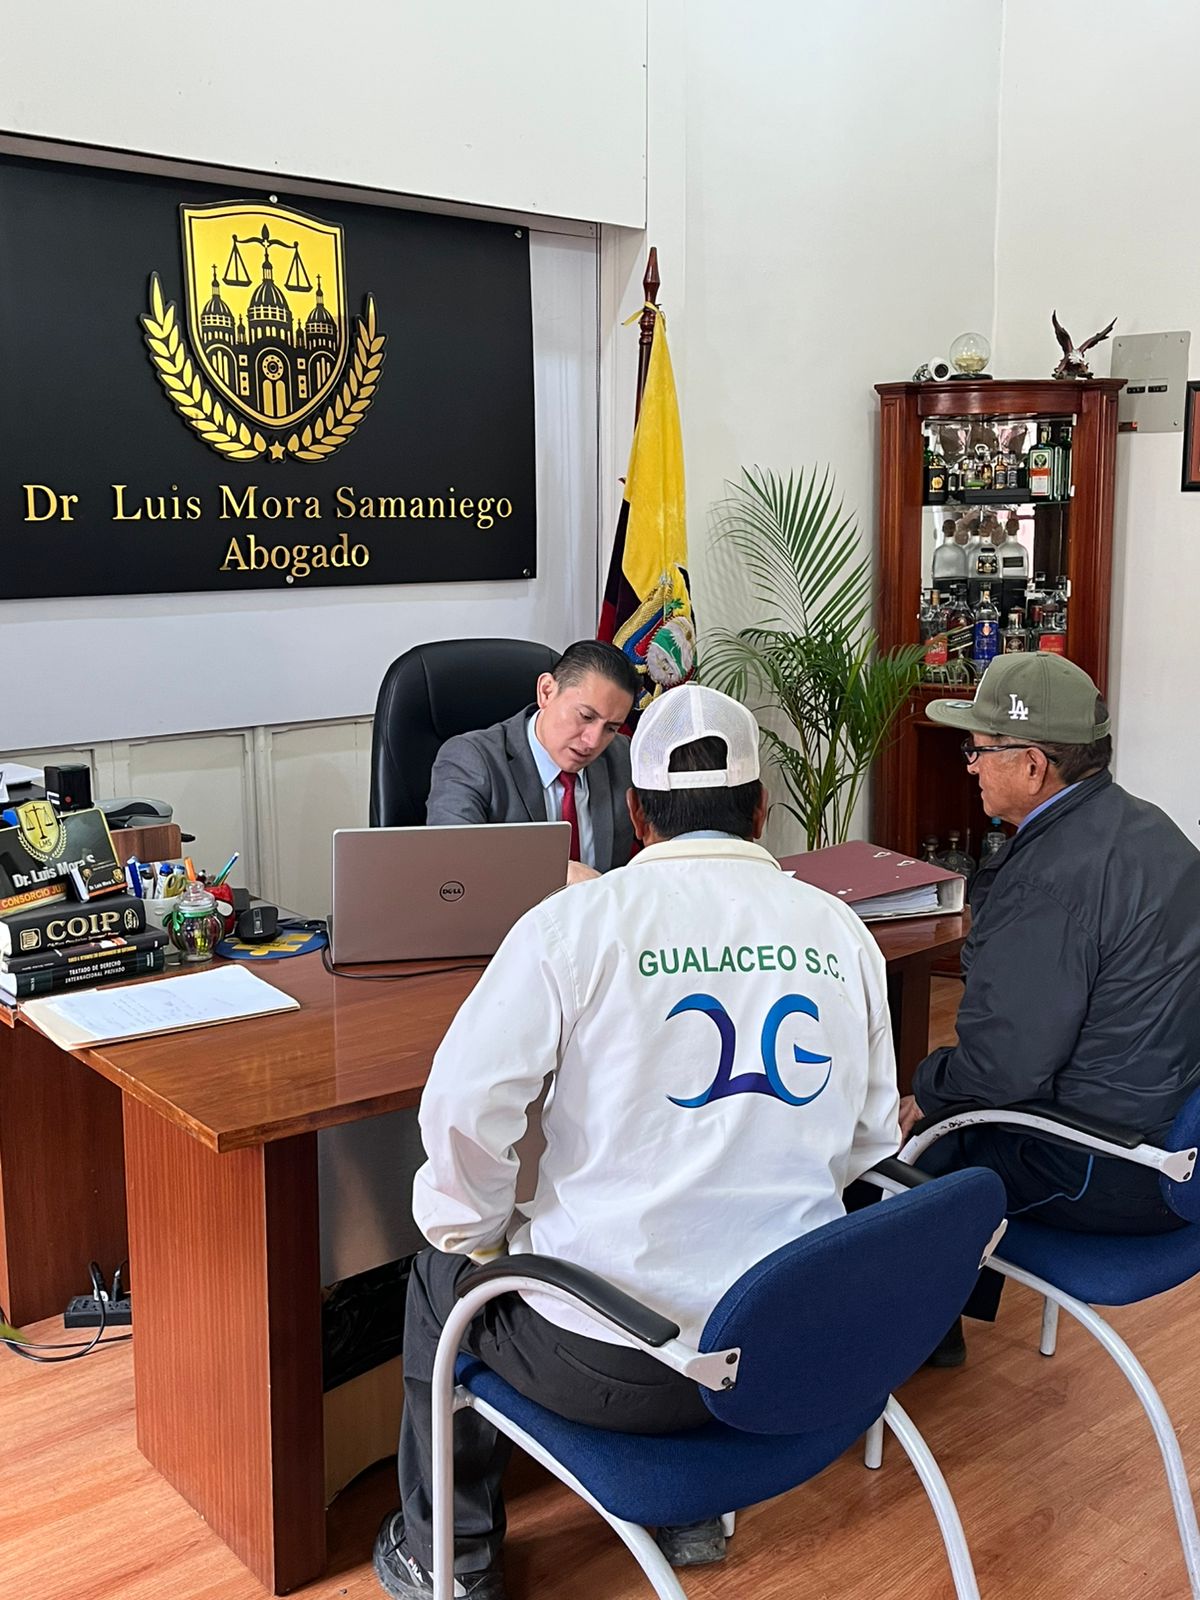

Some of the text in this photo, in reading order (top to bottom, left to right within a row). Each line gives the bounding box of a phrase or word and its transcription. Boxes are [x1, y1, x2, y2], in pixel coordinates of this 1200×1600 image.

[22, 484, 513, 530] Dr Luis Mora Samaniego
[219, 533, 370, 577] Abogado
[1008, 694, 1029, 720] LA
[12, 873, 32, 889] Dr.
[29, 866, 57, 884] Luis
[1, 889, 50, 908] CONSORCIO
[46, 911, 121, 941] COIP
[65, 966, 126, 984] INTERNACIONAL PRIVADO
[69, 966, 91, 975] TRATADO
[100, 960, 122, 970] DERECHO
[638, 945, 846, 982] GUALACEO S.C.
